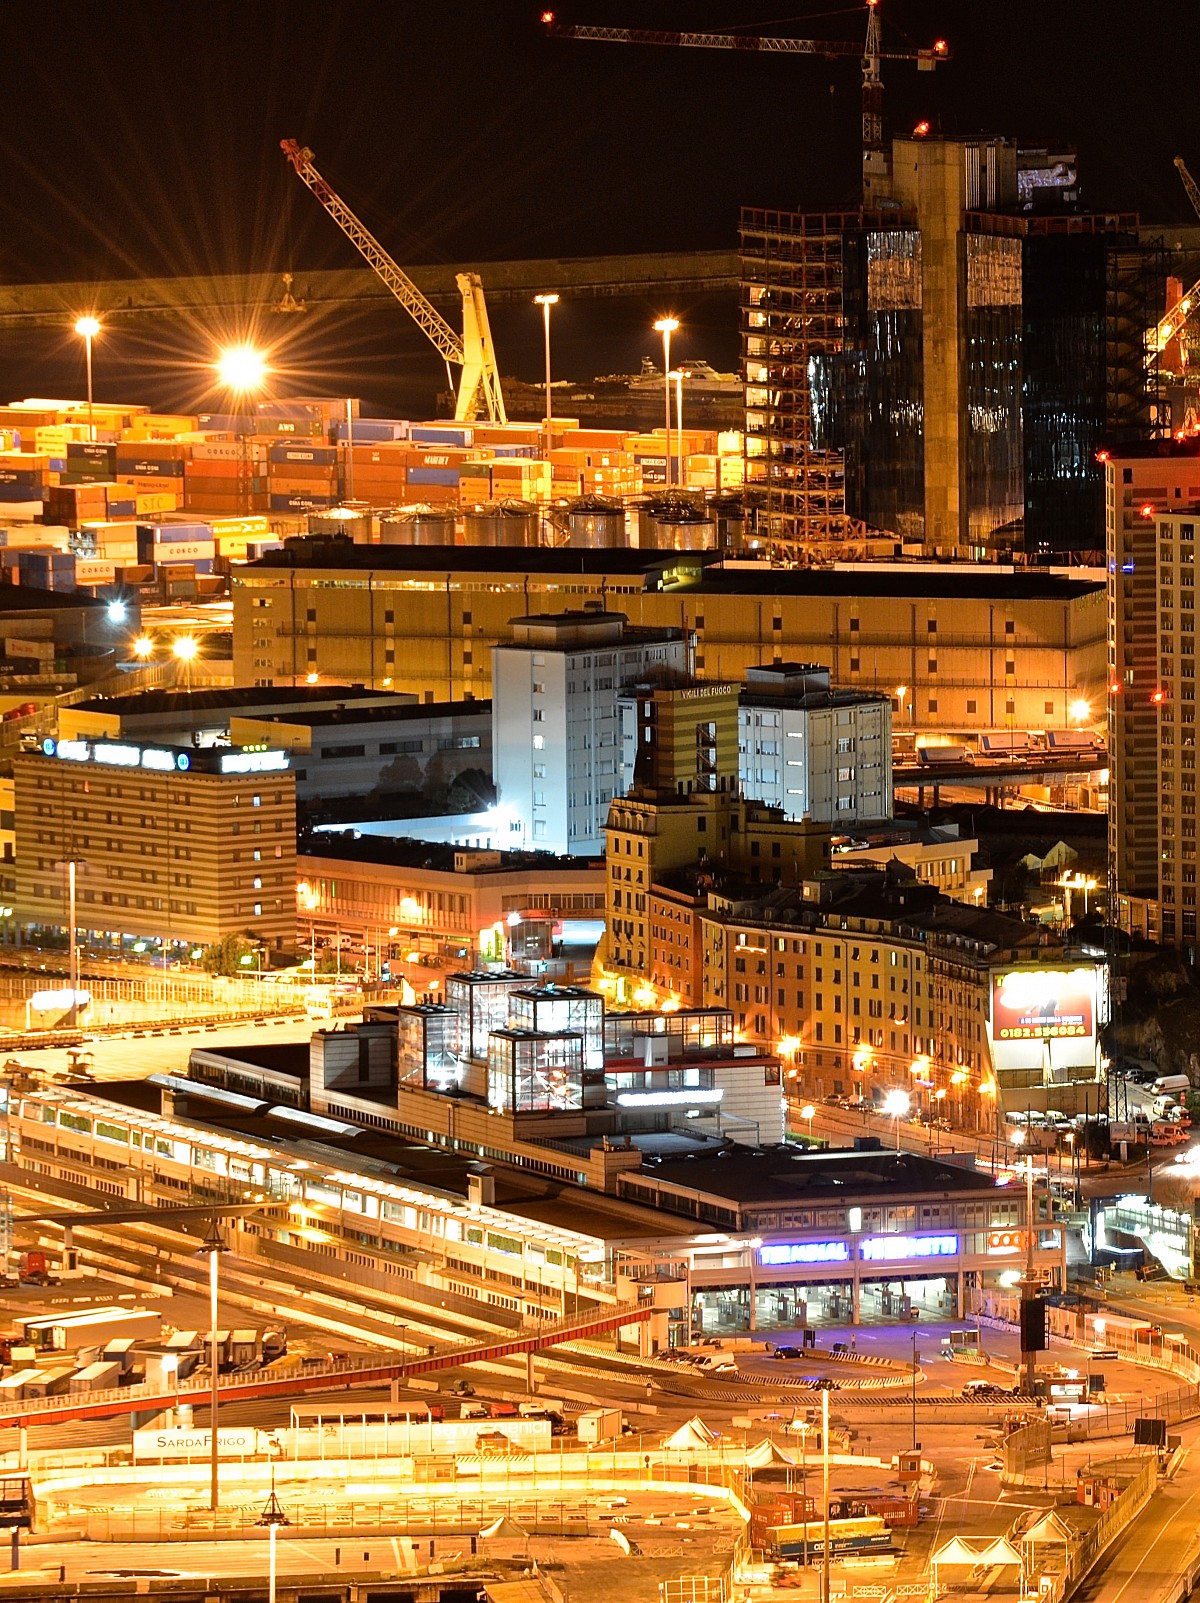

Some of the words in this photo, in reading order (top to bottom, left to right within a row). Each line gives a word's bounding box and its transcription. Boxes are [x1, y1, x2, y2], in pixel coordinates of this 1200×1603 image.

[278, 423, 295, 432] AWS
[169, 547, 198, 555] COSCO
[81, 566, 110, 574] COSCO
[681, 689, 699, 699] VIGILI
[700, 688, 710, 697] DEL
[711, 685, 731, 696] FUOCO
